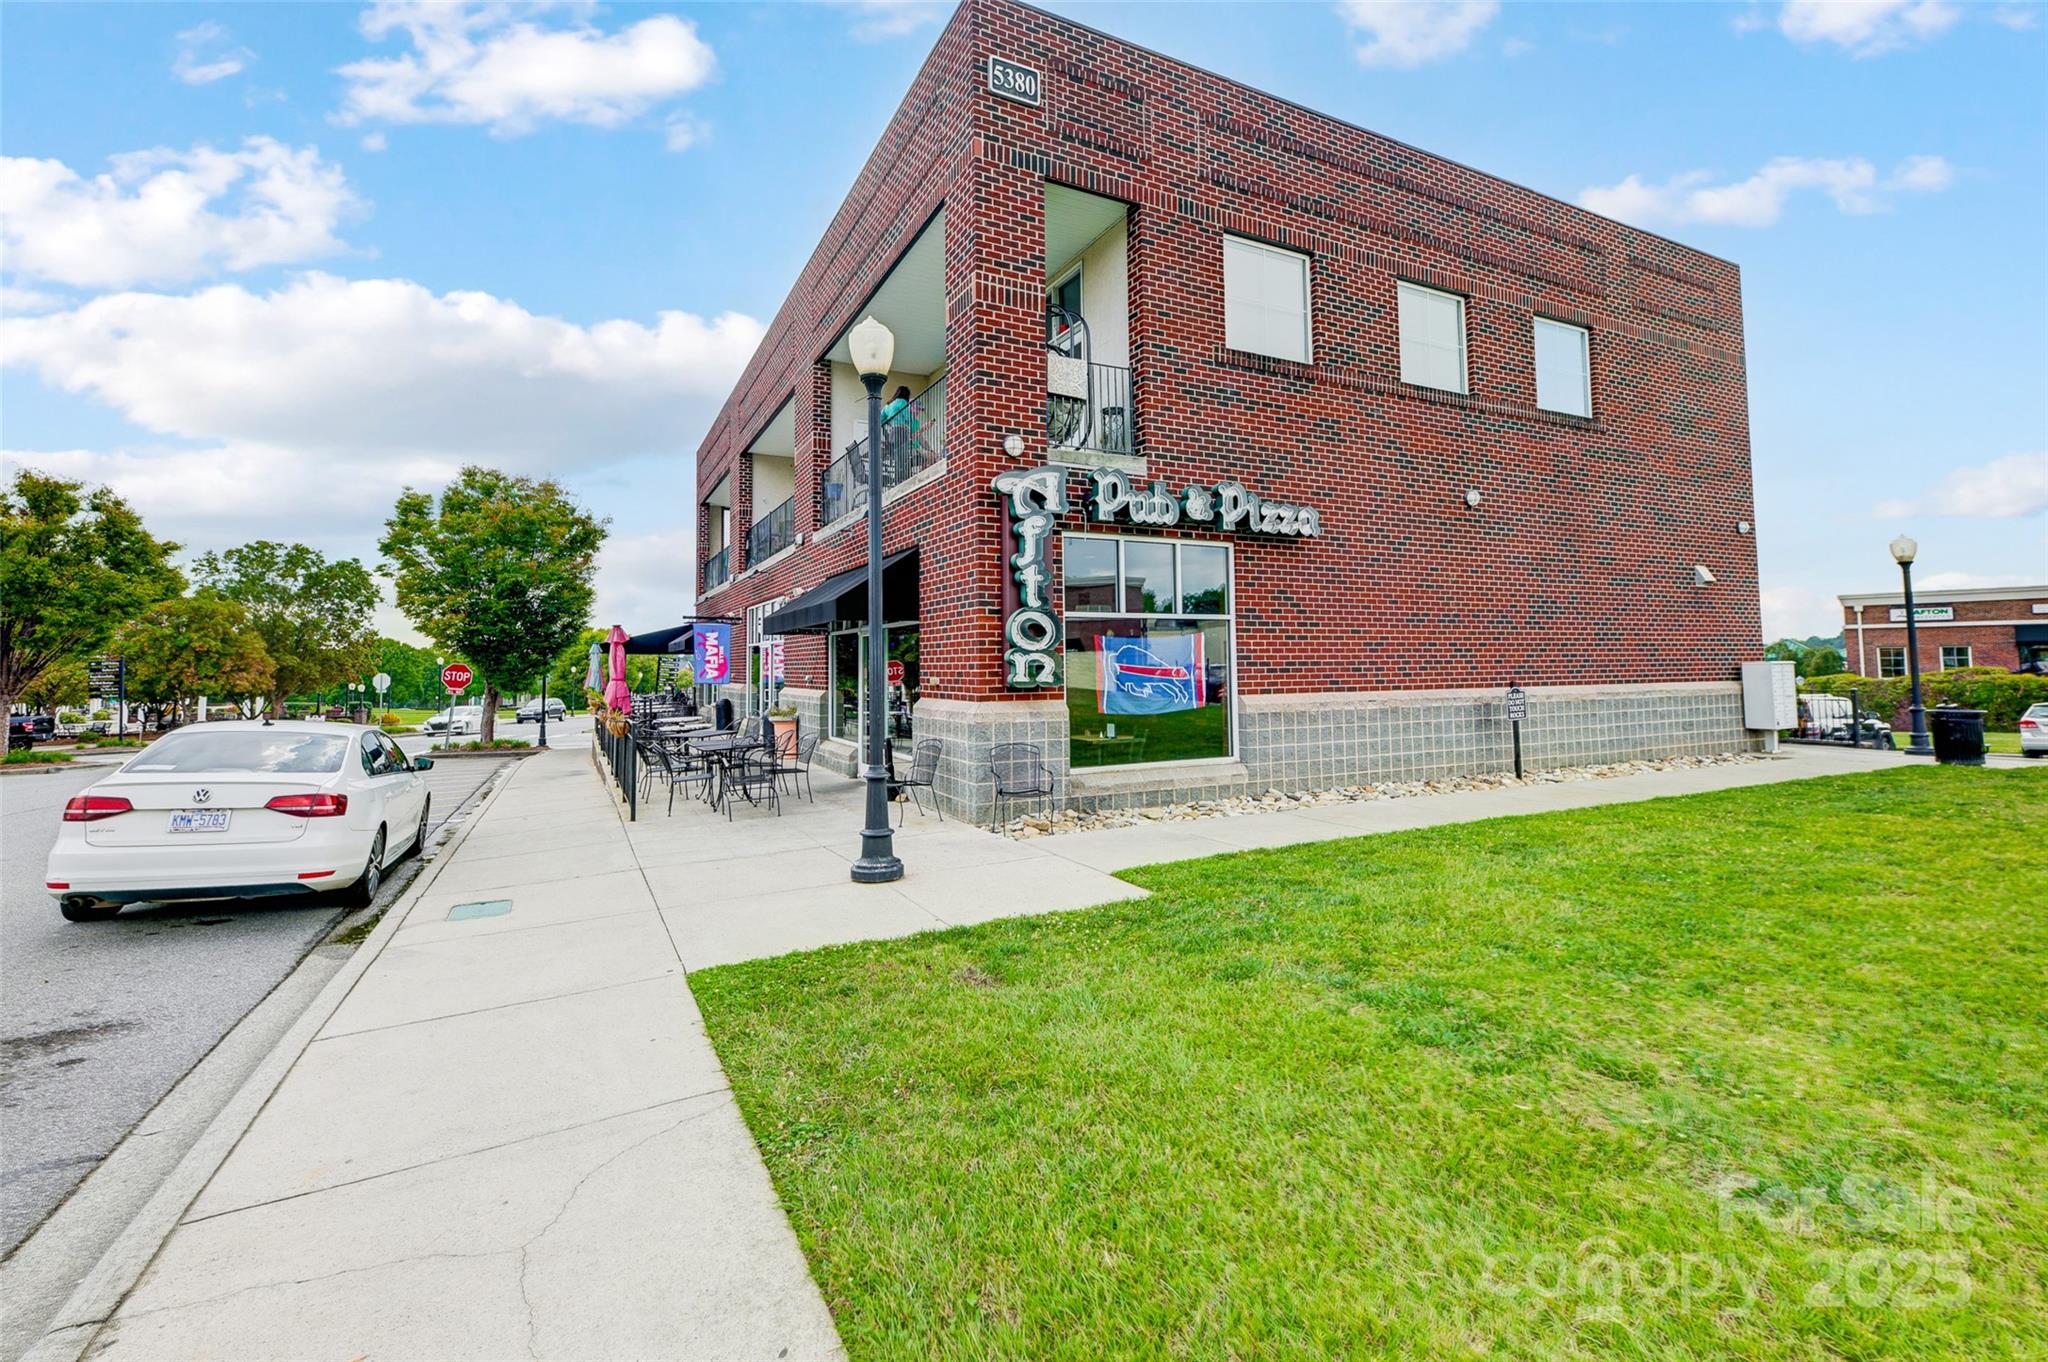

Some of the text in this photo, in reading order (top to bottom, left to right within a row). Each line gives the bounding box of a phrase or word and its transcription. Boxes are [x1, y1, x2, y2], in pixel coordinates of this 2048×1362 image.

[993, 65, 1036, 96] 5380
[1088, 466, 1322, 538] Pub & Pizza
[991, 465, 1069, 688] Afton
[705, 631, 719, 679] MAFIA
[444, 670, 470, 682] STOP
[171, 813, 227, 827] KMW-5783
